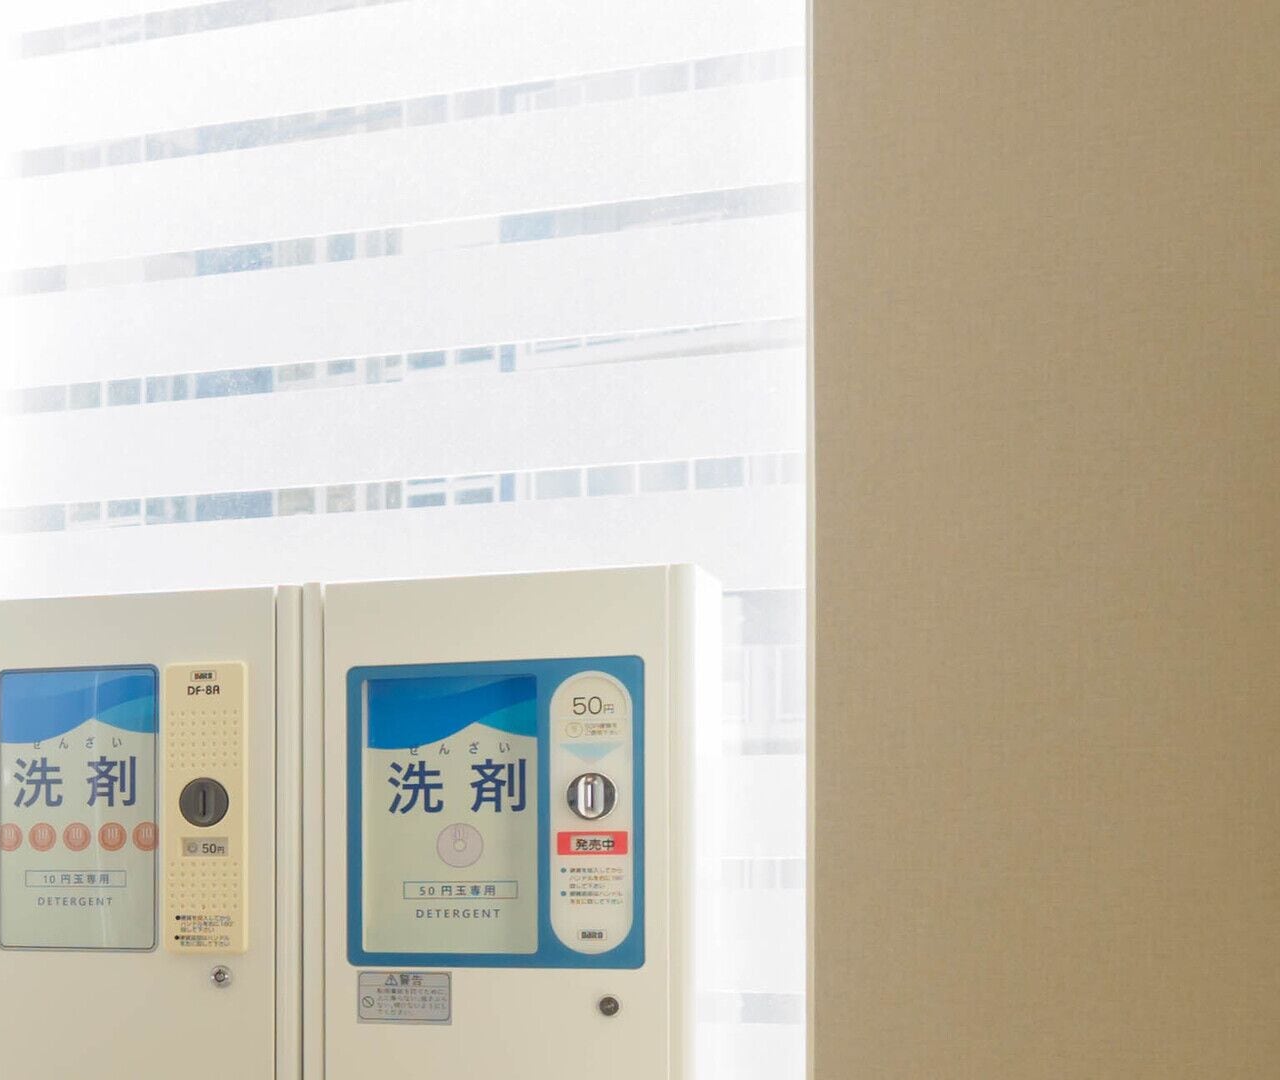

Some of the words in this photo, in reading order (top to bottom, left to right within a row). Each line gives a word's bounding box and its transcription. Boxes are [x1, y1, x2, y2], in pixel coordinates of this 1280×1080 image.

[187, 685, 221, 696] DF-8A
[572, 696, 615, 715] 50円
[13, 756, 137, 808] 洗剤
[387, 758, 527, 815] 洗剤
[202, 843, 225, 854] 50円
[575, 838, 615, 851] 発売中
[37, 896, 113, 907] DETERGENT
[416, 908, 501, 919] DETERGENT
